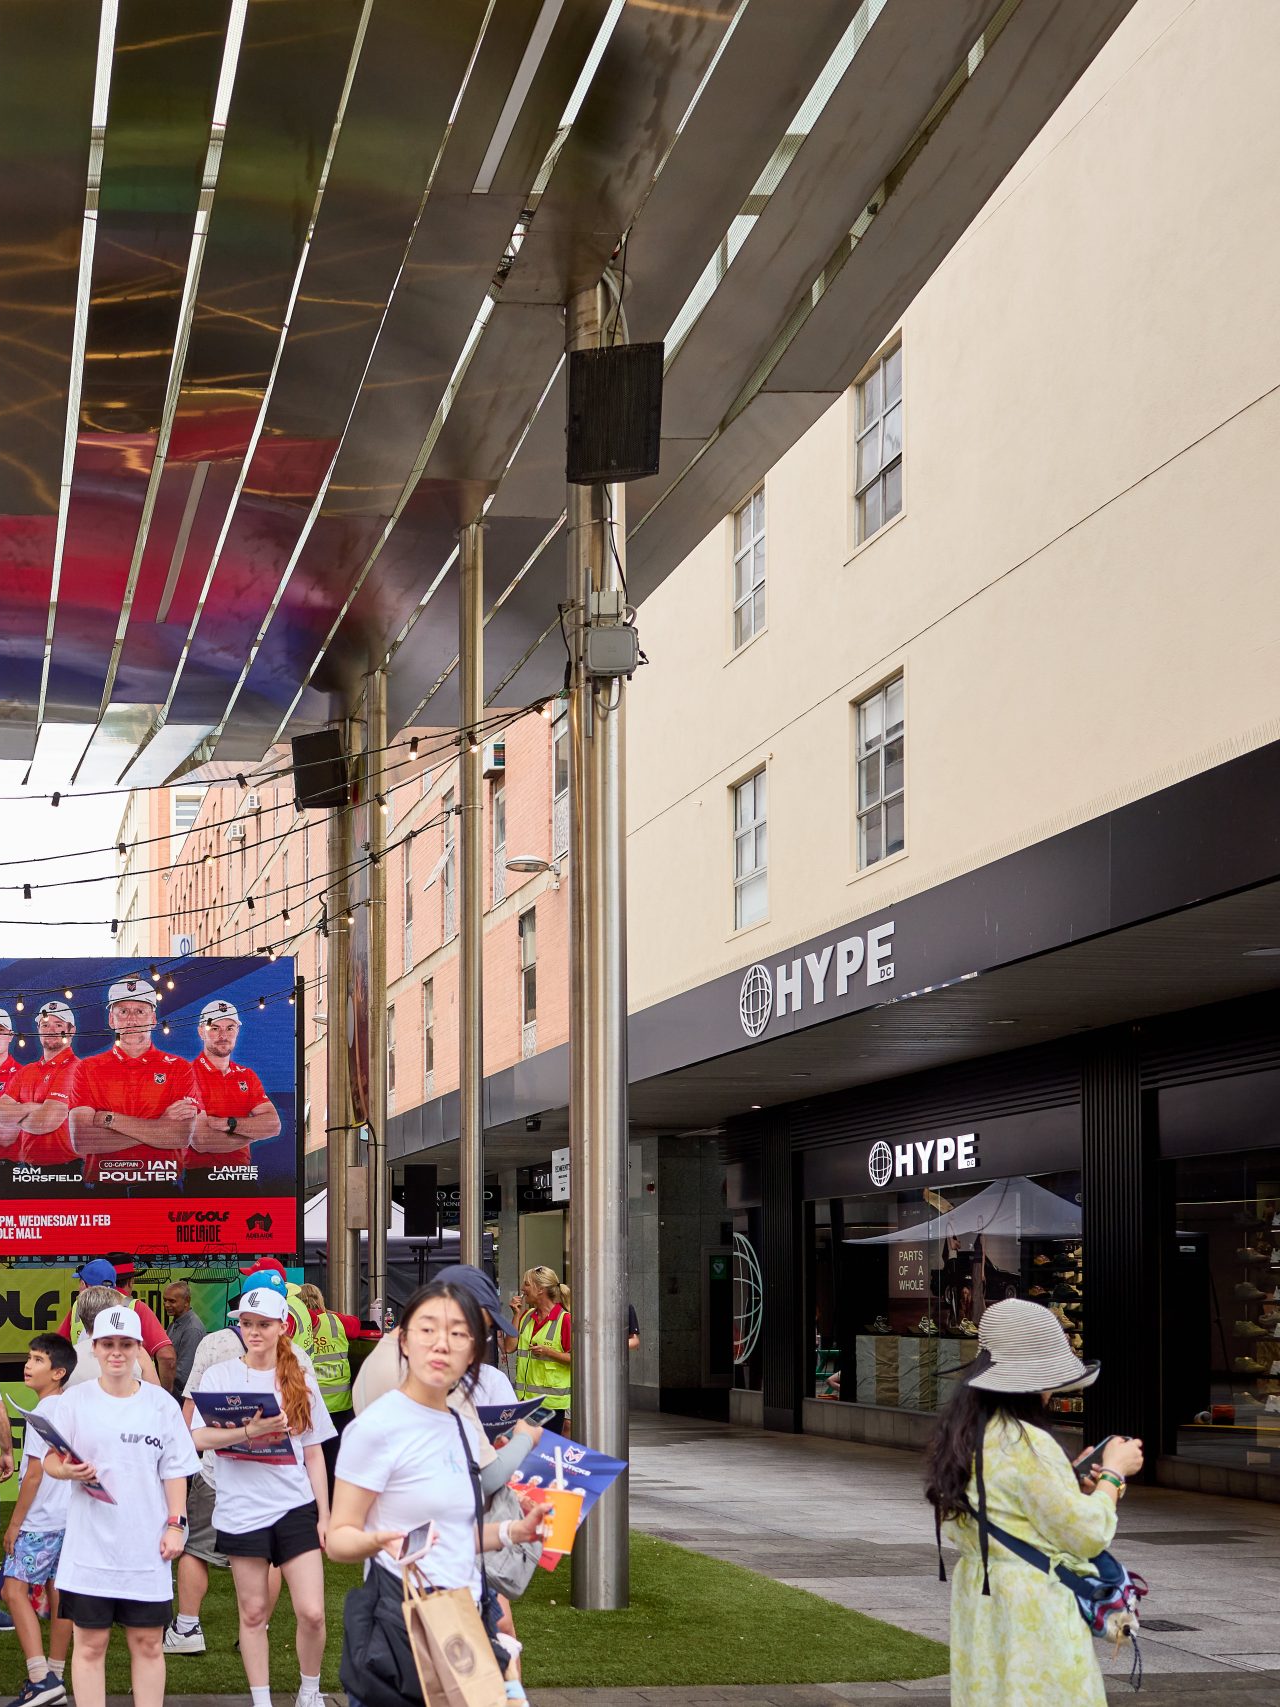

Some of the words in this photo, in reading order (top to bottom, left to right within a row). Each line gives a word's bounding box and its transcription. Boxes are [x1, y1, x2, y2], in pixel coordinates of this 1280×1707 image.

[776, 921, 895, 1018] HYPE
[880, 966, 892, 979] DC
[895, 1133, 976, 1177] HYPE
[147, 1160, 177, 1170] IAN
[213, 1165, 258, 1173] LAURIE
[12, 1167, 41, 1175] SAM
[99, 1171, 178, 1182] POULTER
[12, 1174, 83, 1182] HORSFIELD
[207, 1173, 258, 1181] CANTER
[19, 1215, 78, 1226] WEDNESDAY
[80, 1215, 91, 1226] 11
[92, 1214, 111, 1226] FEB
[16, 1228, 42, 1239] MALL
[899, 1250, 923, 1261] PARTS
[899, 1265, 908, 1276] OF
[918, 1265, 924, 1276] A
[899, 1280, 924, 1290] WHOLE
[313, 1336, 327, 1346] RS
[120, 1432, 145, 1443] LIV
[145, 1435, 163, 1450] GOL
